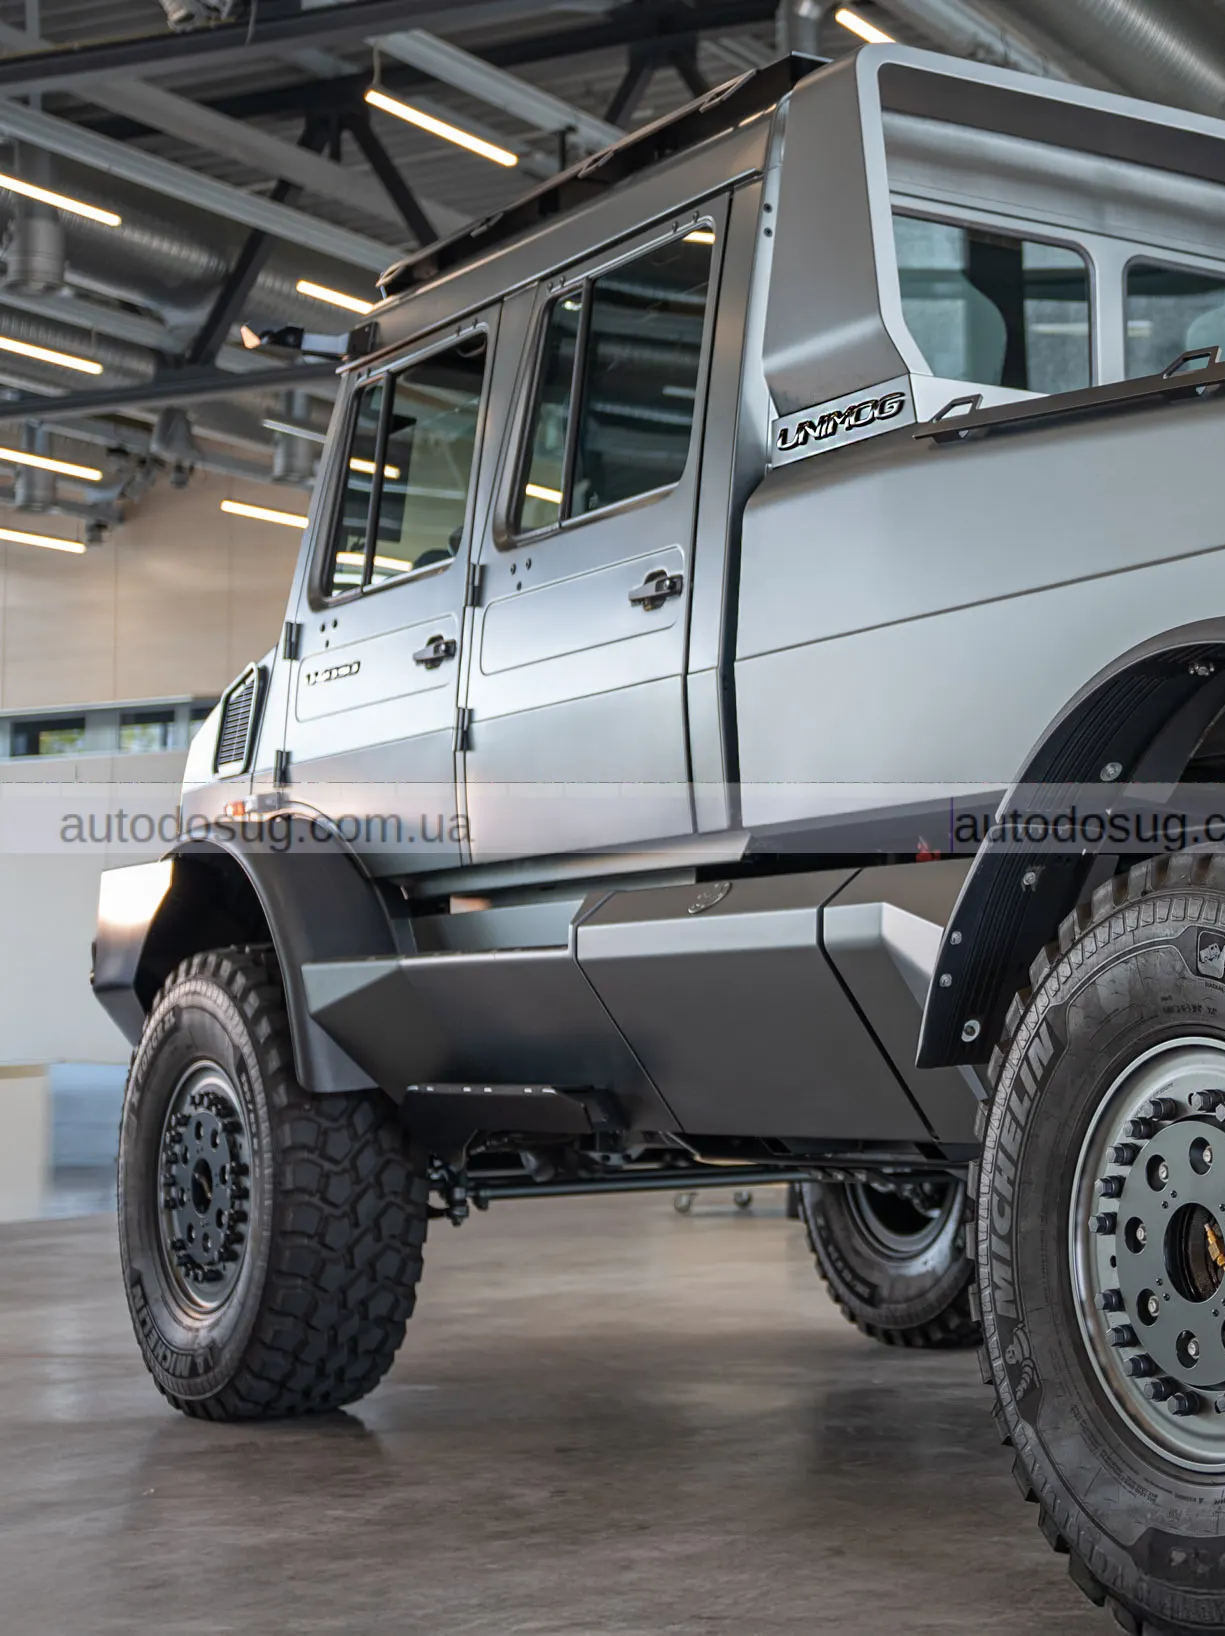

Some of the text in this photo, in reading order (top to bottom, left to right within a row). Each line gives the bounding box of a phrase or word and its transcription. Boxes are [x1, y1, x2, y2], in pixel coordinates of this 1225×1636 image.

[776, 392, 905, 451] UNIMOG
[990, 1018, 1055, 1319] MICHELIN
[131, 1283, 192, 1377] MICHELIN
